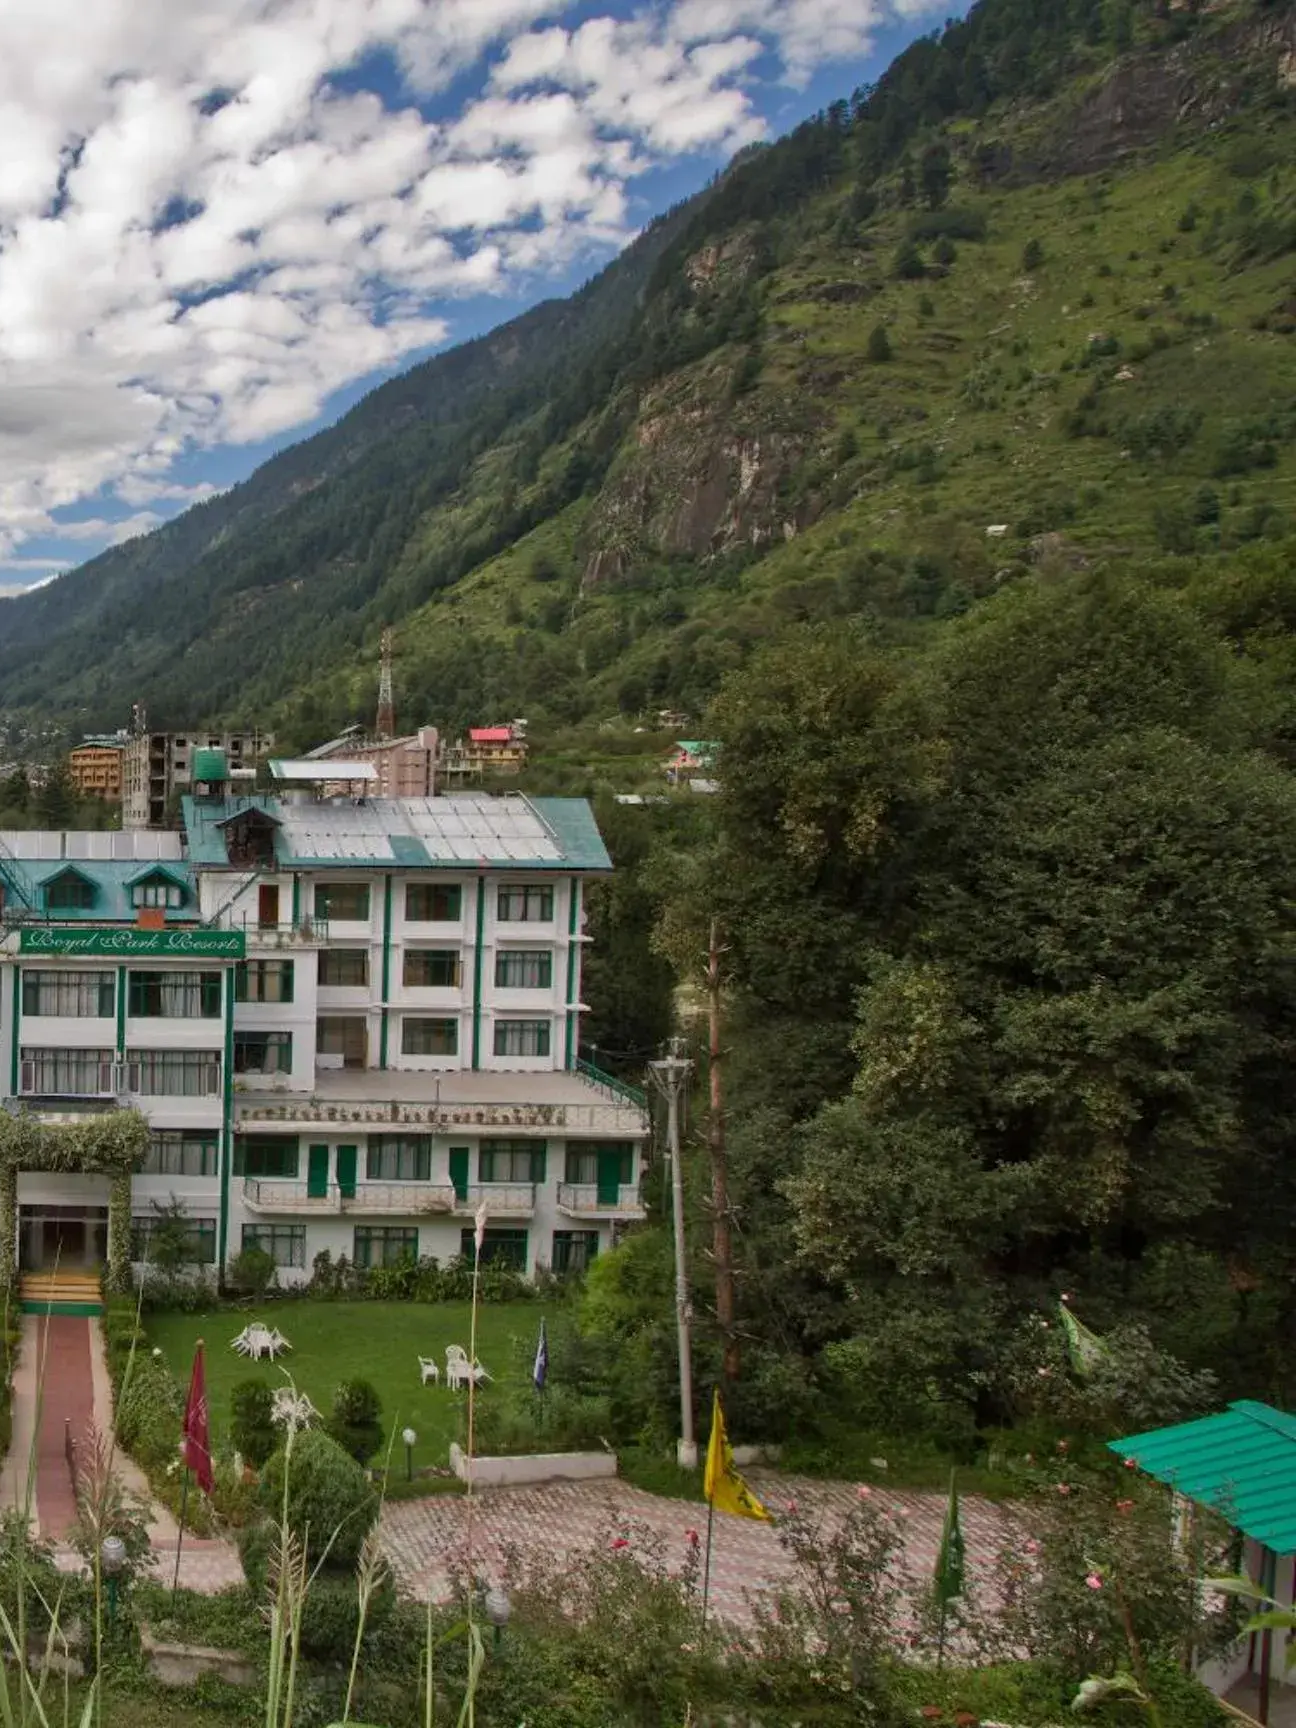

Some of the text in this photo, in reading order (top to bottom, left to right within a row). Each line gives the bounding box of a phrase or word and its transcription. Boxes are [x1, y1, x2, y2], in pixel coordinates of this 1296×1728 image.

[26, 931, 240, 952] Royal Park Resorts
